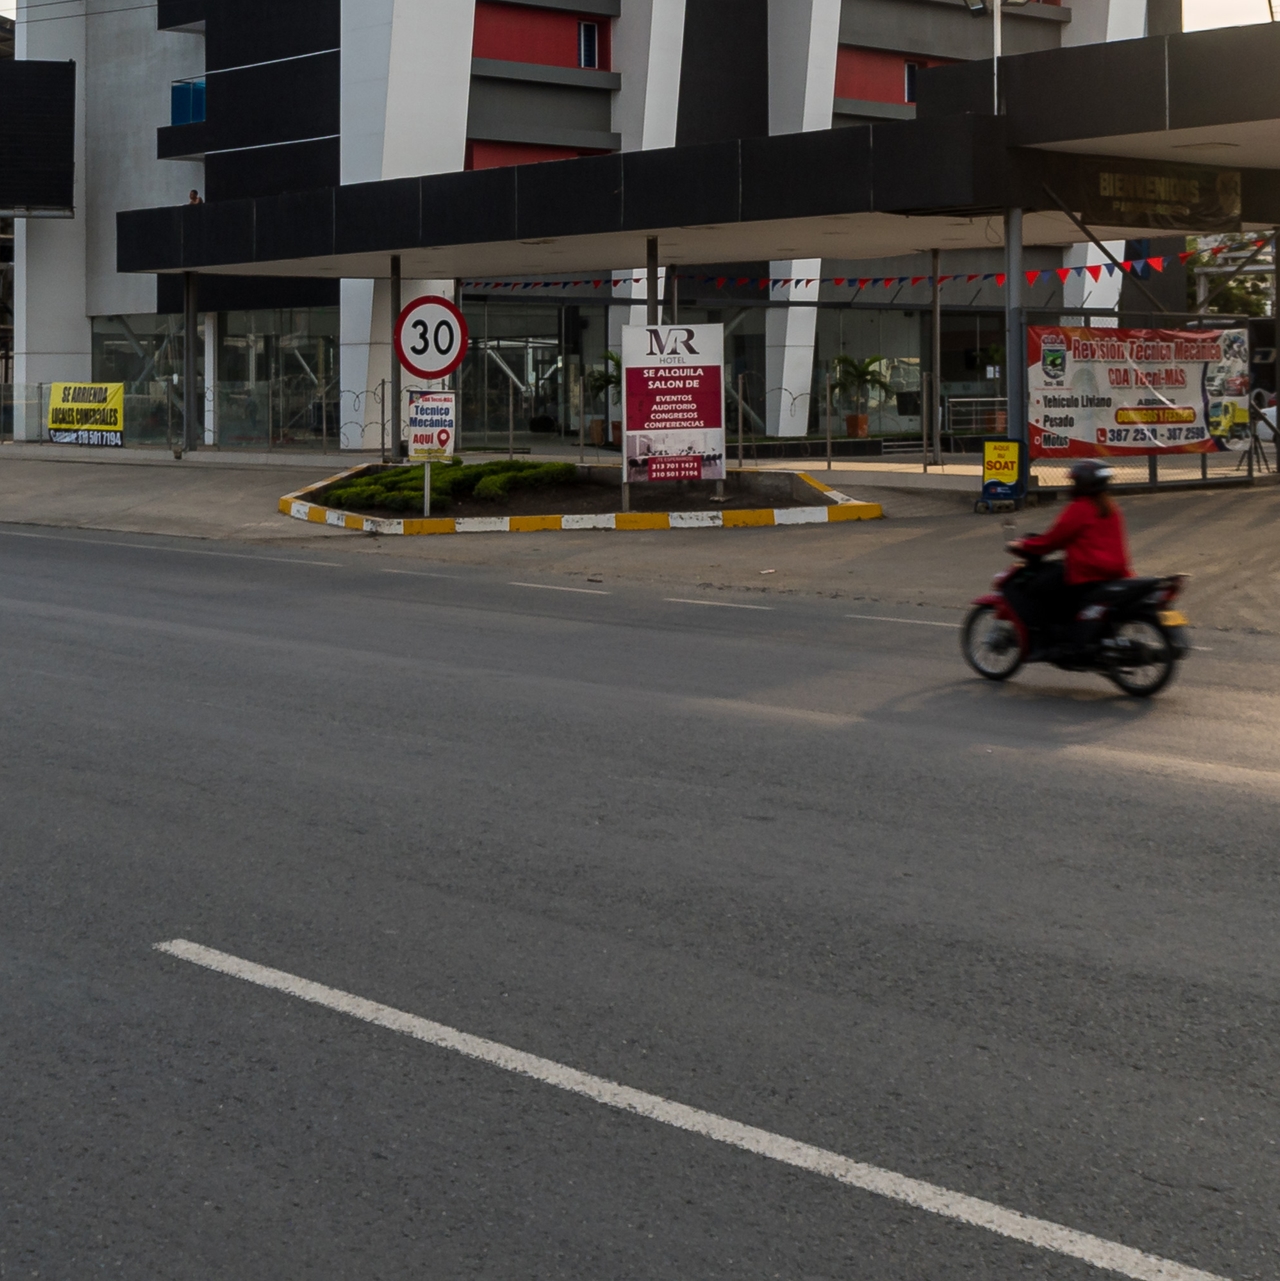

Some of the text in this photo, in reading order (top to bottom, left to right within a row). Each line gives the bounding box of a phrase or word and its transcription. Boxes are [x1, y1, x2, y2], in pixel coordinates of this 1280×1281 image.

[410, 319, 455, 356] 30
[646, 328, 700, 356] MR
[1072, 337, 1124, 359] Revisión
[643, 368, 704, 378] SE ALQUILA
[1108, 368, 1130, 386] CDA
[648, 379, 700, 389] SALON DE
[62, 386, 108, 403] SE ARRIENDA
[651, 403, 697, 411] AUDITORIO
[1042, 394, 1112, 408] Vehículo Liviano
[51, 407, 118, 426] LOCALES COMERCIALES
[414, 405, 450, 416] Técnico
[650, 412, 698, 420] CONGRESOS
[409, 417, 454, 428] Mecánica
[644, 420, 705, 429] CONFERENCIAS
[1043, 415, 1074, 427] Pesado
[89, 431, 102, 445] 501
[102, 432, 122, 446] 7194
[413, 432, 434, 445] AQUÍ
[1042, 434, 1069, 446] Motos
[1108, 429, 1130, 441] 387
[986, 460, 1016, 471] SOAT
